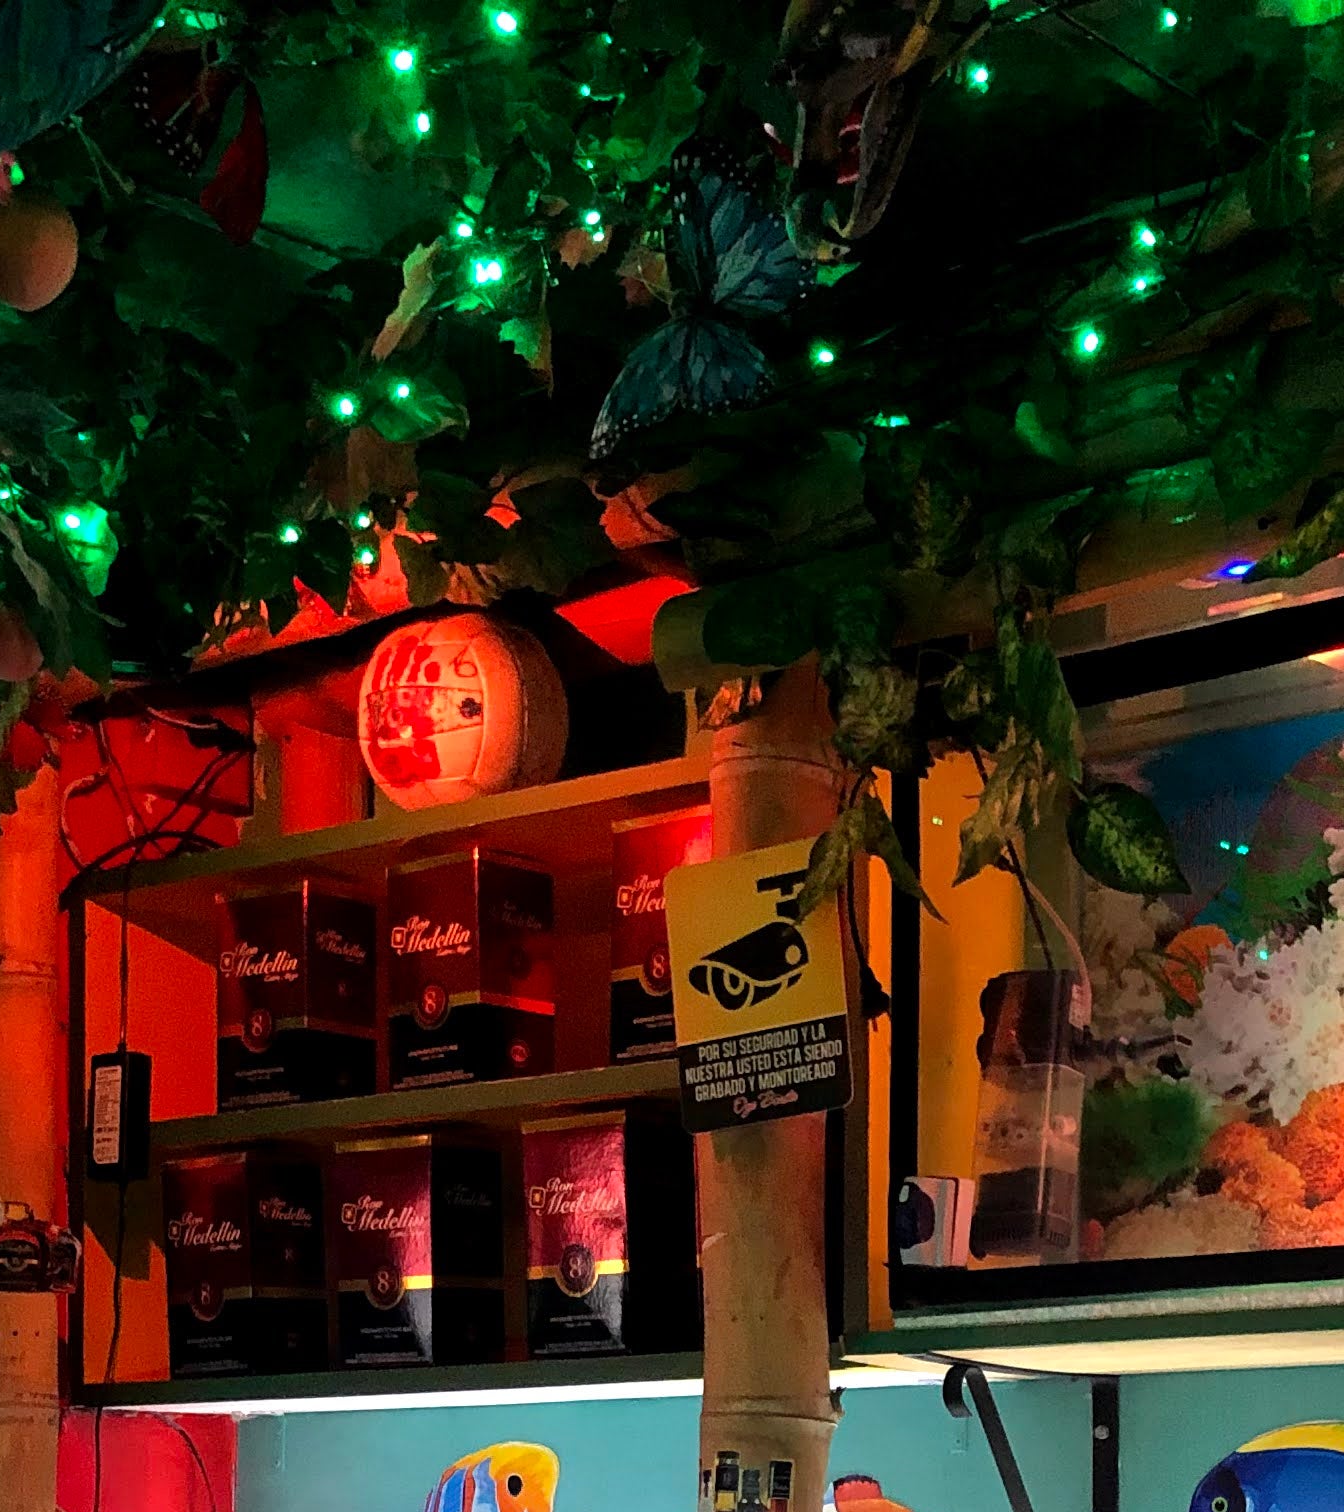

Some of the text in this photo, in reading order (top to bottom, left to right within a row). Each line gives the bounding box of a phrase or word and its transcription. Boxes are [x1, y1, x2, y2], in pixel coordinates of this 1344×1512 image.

[699, 1023, 826, 1063] POR SU SEGURIDAD Y LA
[685, 1040, 843, 1085] NUESTRA USTED ESTA SIENDO
[695, 1061, 836, 1102] GRABADO Y MONITOREADO
[546, 1177, 573, 1193] Ron
[377, 1270, 389, 1294] 8
[569, 1255, 582, 1279] 8
